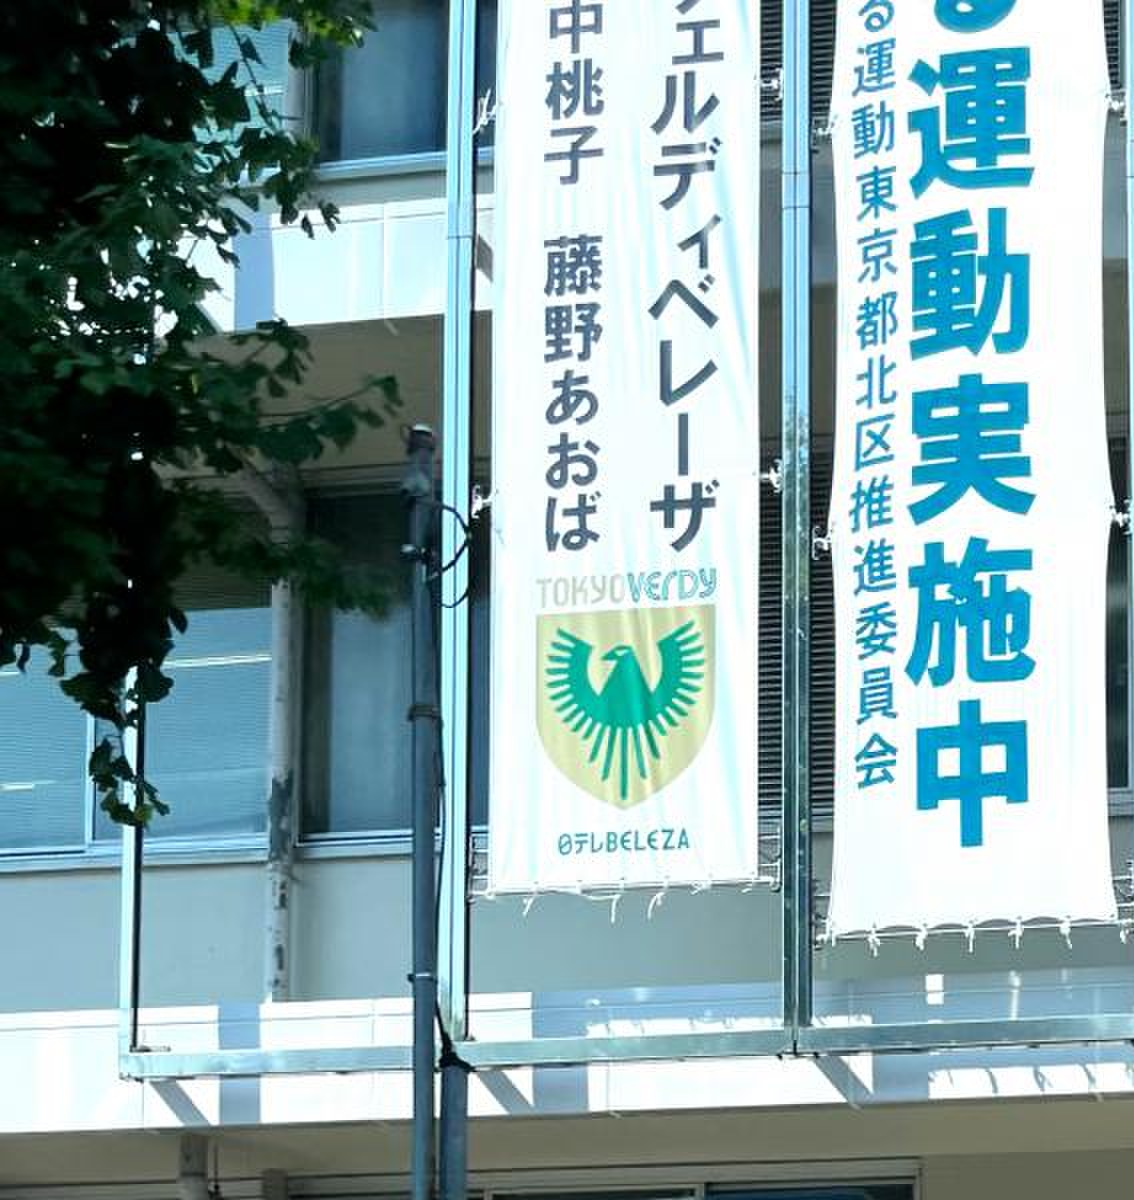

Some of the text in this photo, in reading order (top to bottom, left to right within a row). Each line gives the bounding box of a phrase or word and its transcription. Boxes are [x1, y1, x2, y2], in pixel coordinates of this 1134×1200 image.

[543, 0, 606, 552] 中桃子 藤野あおば
[648, 0, 725, 552] ェルディベレーザ
[905, 0, 1037, 848] 運動実施中
